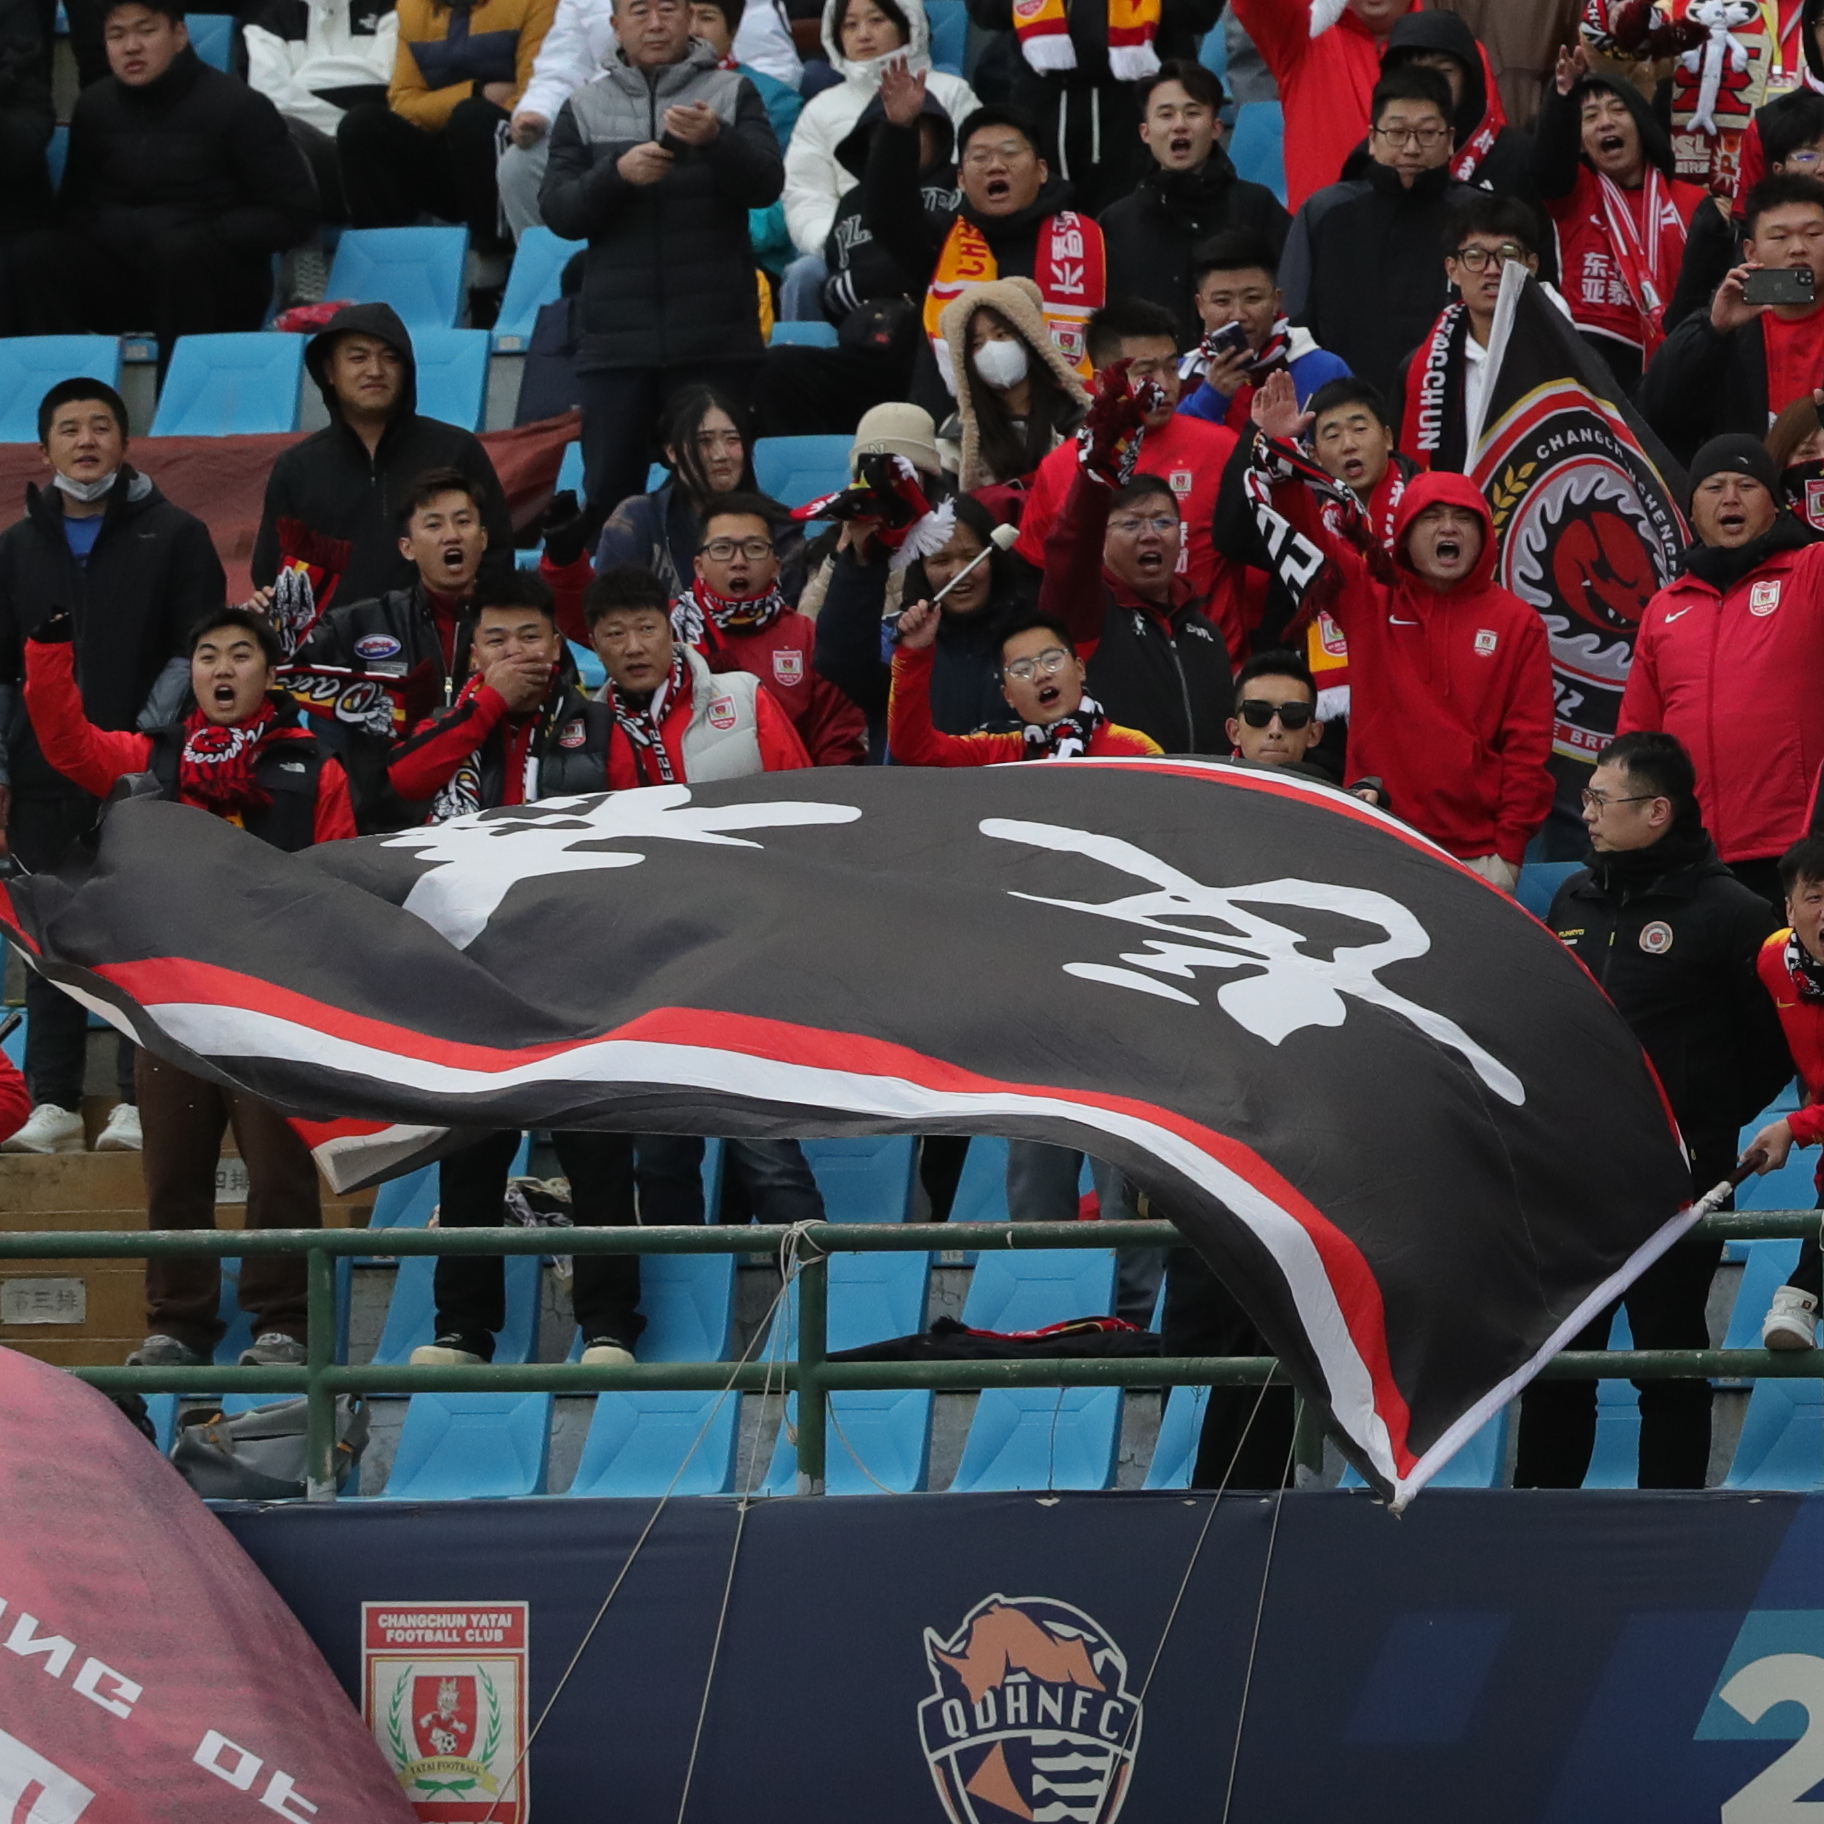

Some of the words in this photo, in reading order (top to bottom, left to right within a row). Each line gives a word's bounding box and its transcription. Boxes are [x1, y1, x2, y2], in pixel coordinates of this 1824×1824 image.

[649, 725, 675, 782] 2023
[377, 1612, 467, 1629] CHANGCHUN
[468, 1612, 513, 1629] YATAI
[385, 1627, 462, 1644] FOOTBALL
[464, 1626, 505, 1643] CLUB
[941, 1685, 1123, 1740] QDHNFC
[408, 1761, 436, 1776] YATAI
[437, 1760, 482, 1777] FOOTBALL
